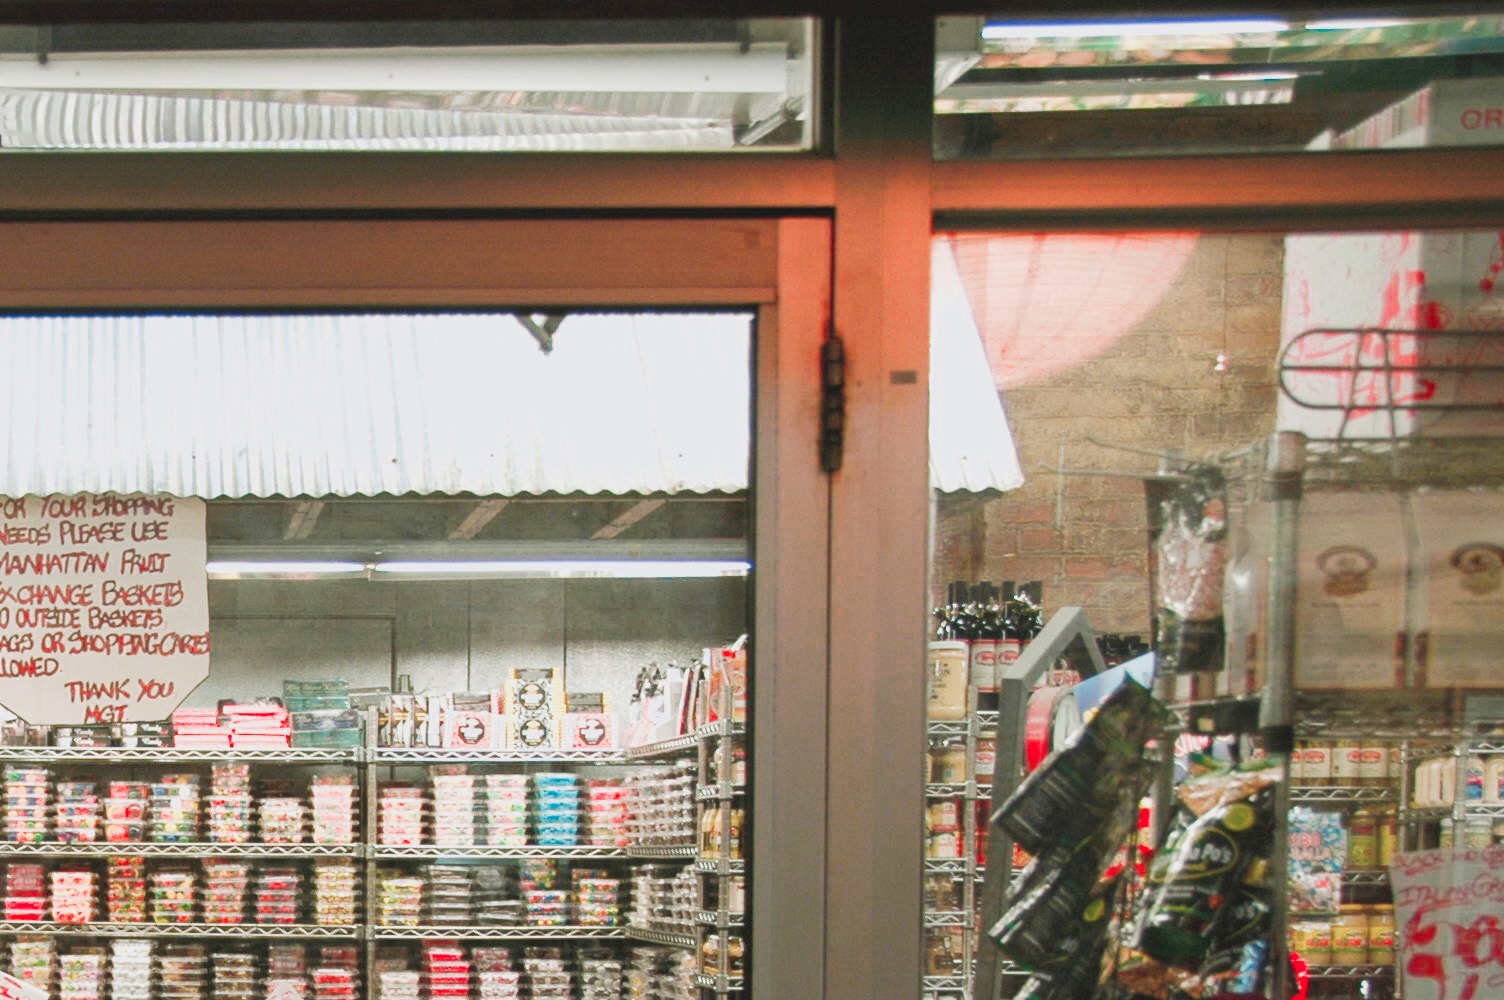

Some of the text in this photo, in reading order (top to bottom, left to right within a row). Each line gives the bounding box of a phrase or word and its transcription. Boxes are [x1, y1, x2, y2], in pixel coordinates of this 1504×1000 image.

[92, 495, 175, 518] SHOPPING
[59, 520, 126, 545] PLEASE
[131, 520, 169, 542] USE
[120, 548, 171, 575] FRUIT
[101, 579, 185, 607] BASKETS
[15, 606, 81, 629] OUTSIDE
[41, 631, 66, 654] OR
[68, 630, 159, 656] SHOPPING
[159, 632, 212, 656] CARTS
[64, 678, 174, 702] THANK YOU
